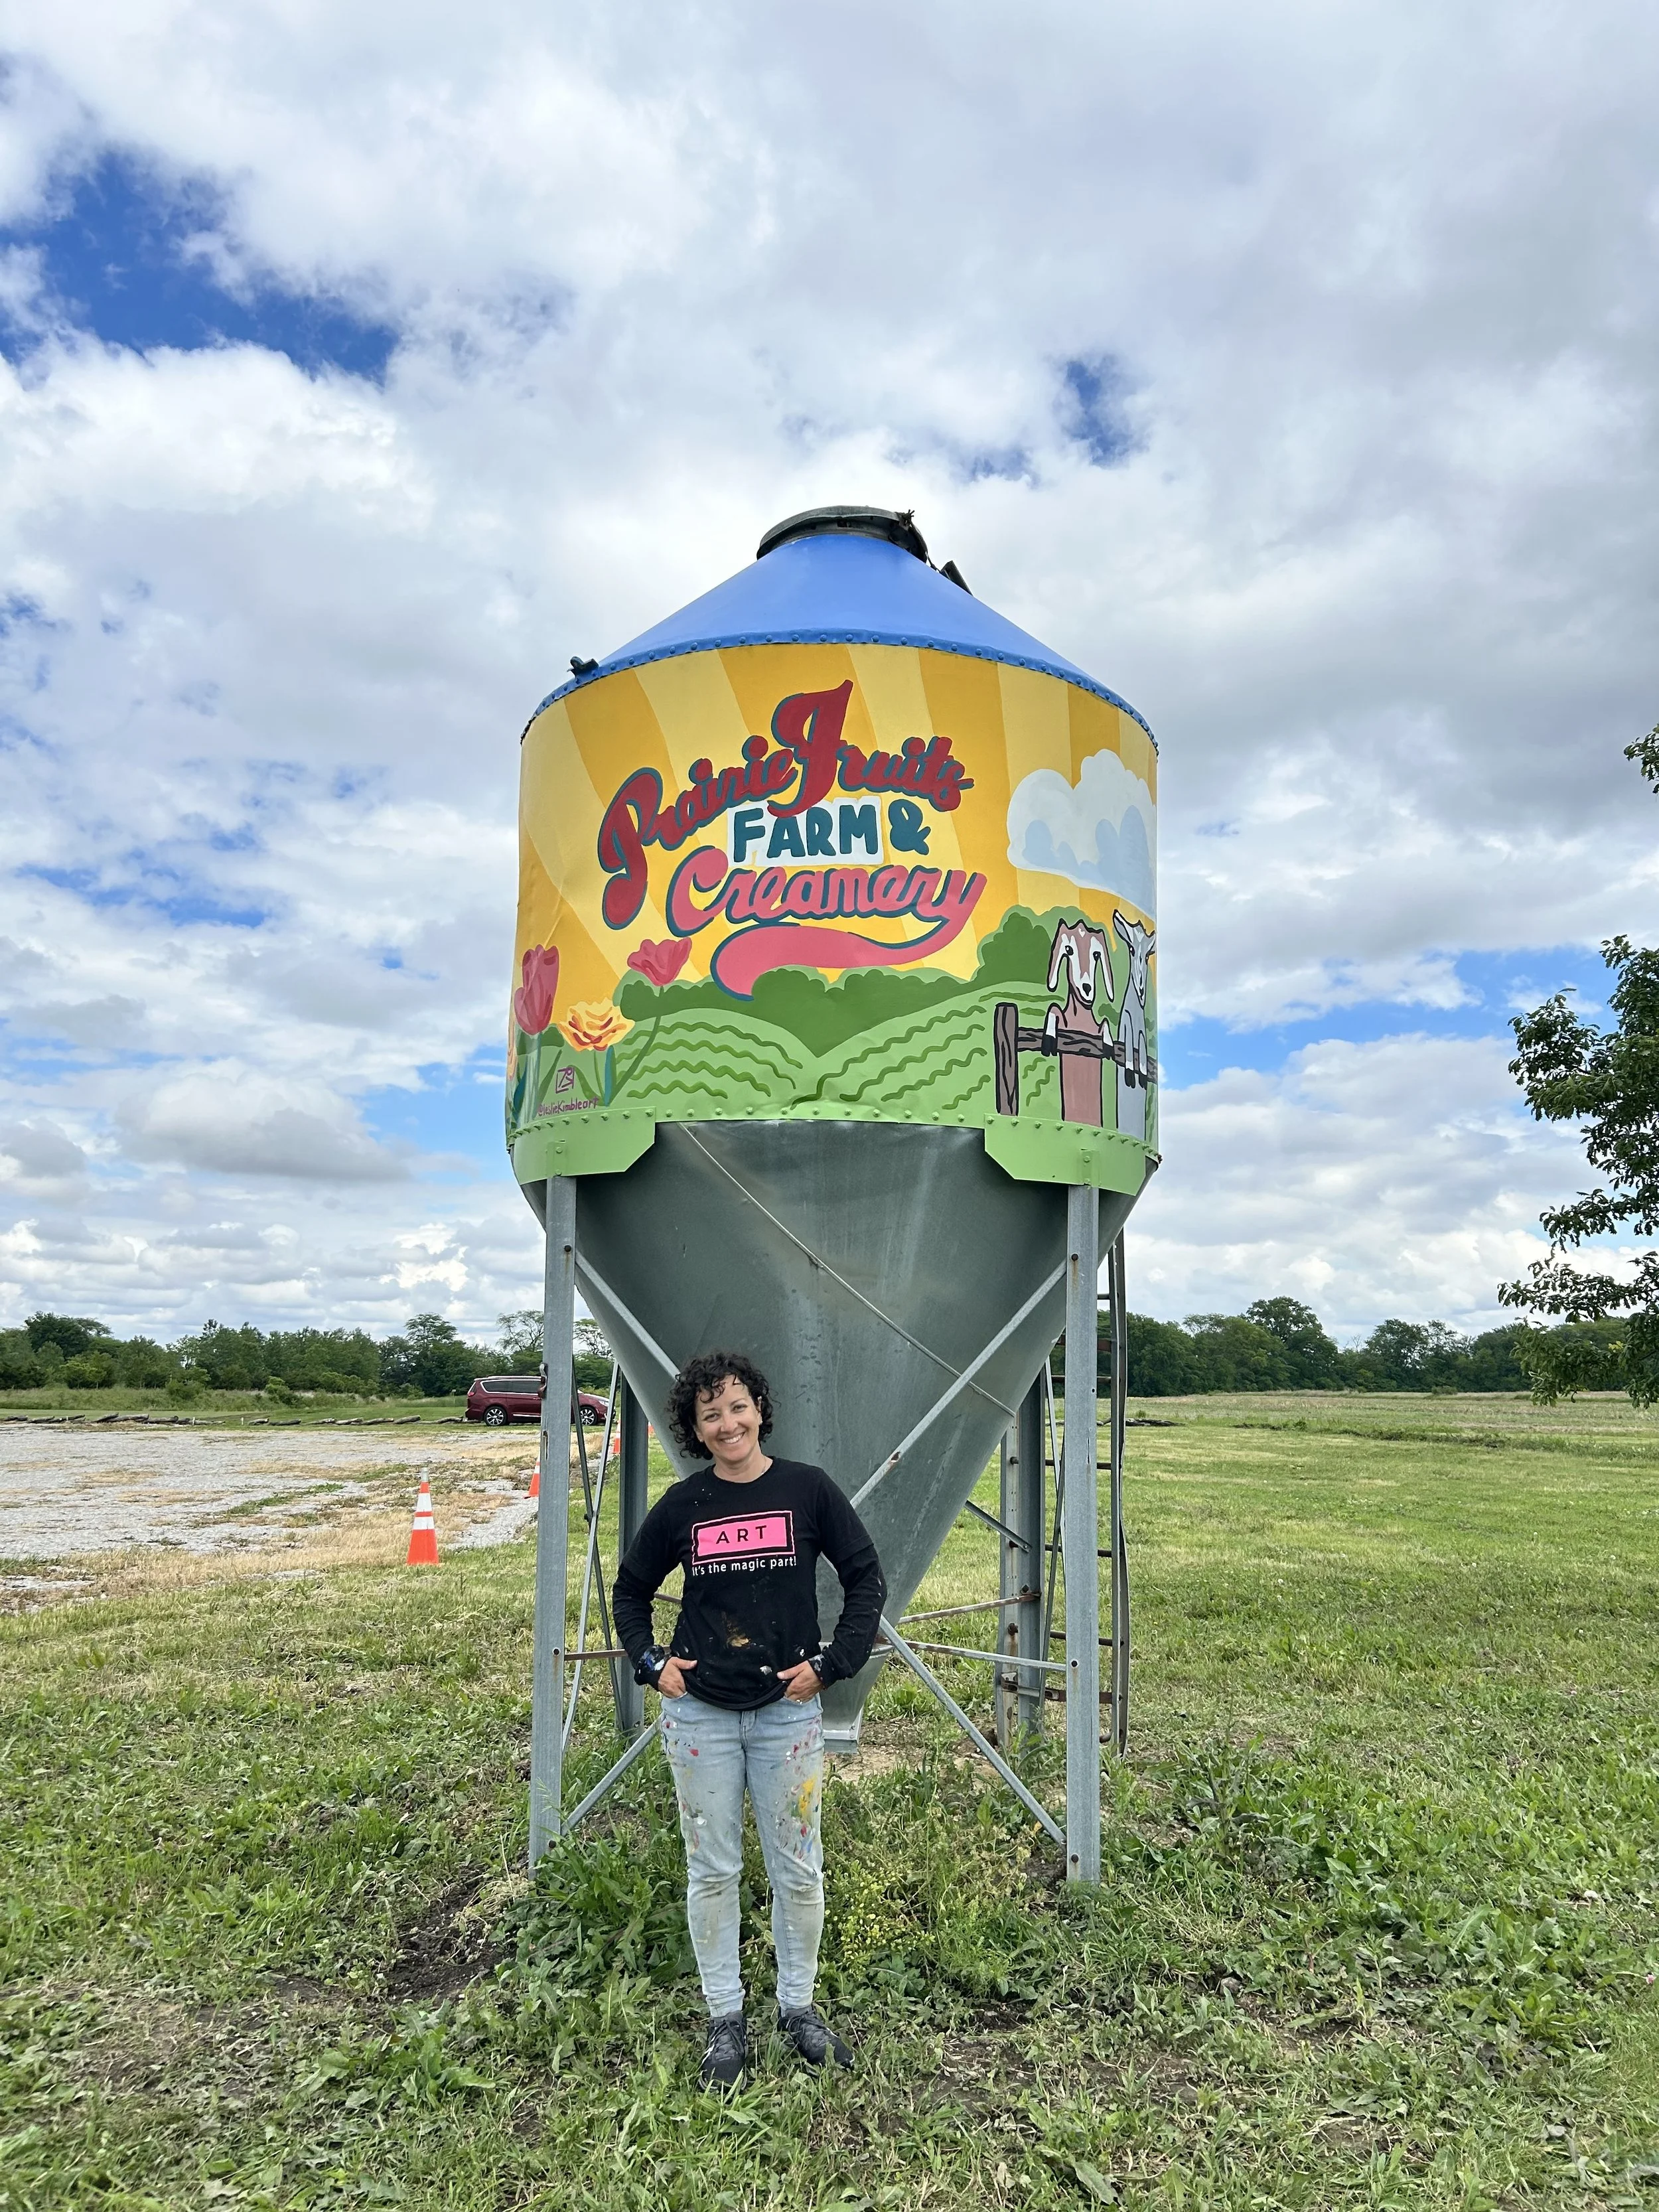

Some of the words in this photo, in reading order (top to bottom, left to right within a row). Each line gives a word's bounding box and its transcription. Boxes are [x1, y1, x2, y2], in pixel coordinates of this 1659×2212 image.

[597, 735, 798, 930] Prairie
[768, 679, 974, 817] Fruits
[733, 804, 878, 863] FARM
[887, 798, 931, 855] &
[665, 845, 987, 1001] Creamery
[692, 1565, 705, 1576] It's
[708, 1562, 727, 1574] the
[731, 1558, 766, 1572] magic
[770, 1556, 796, 1569] part!
[716, 1525, 767, 1544] ART
